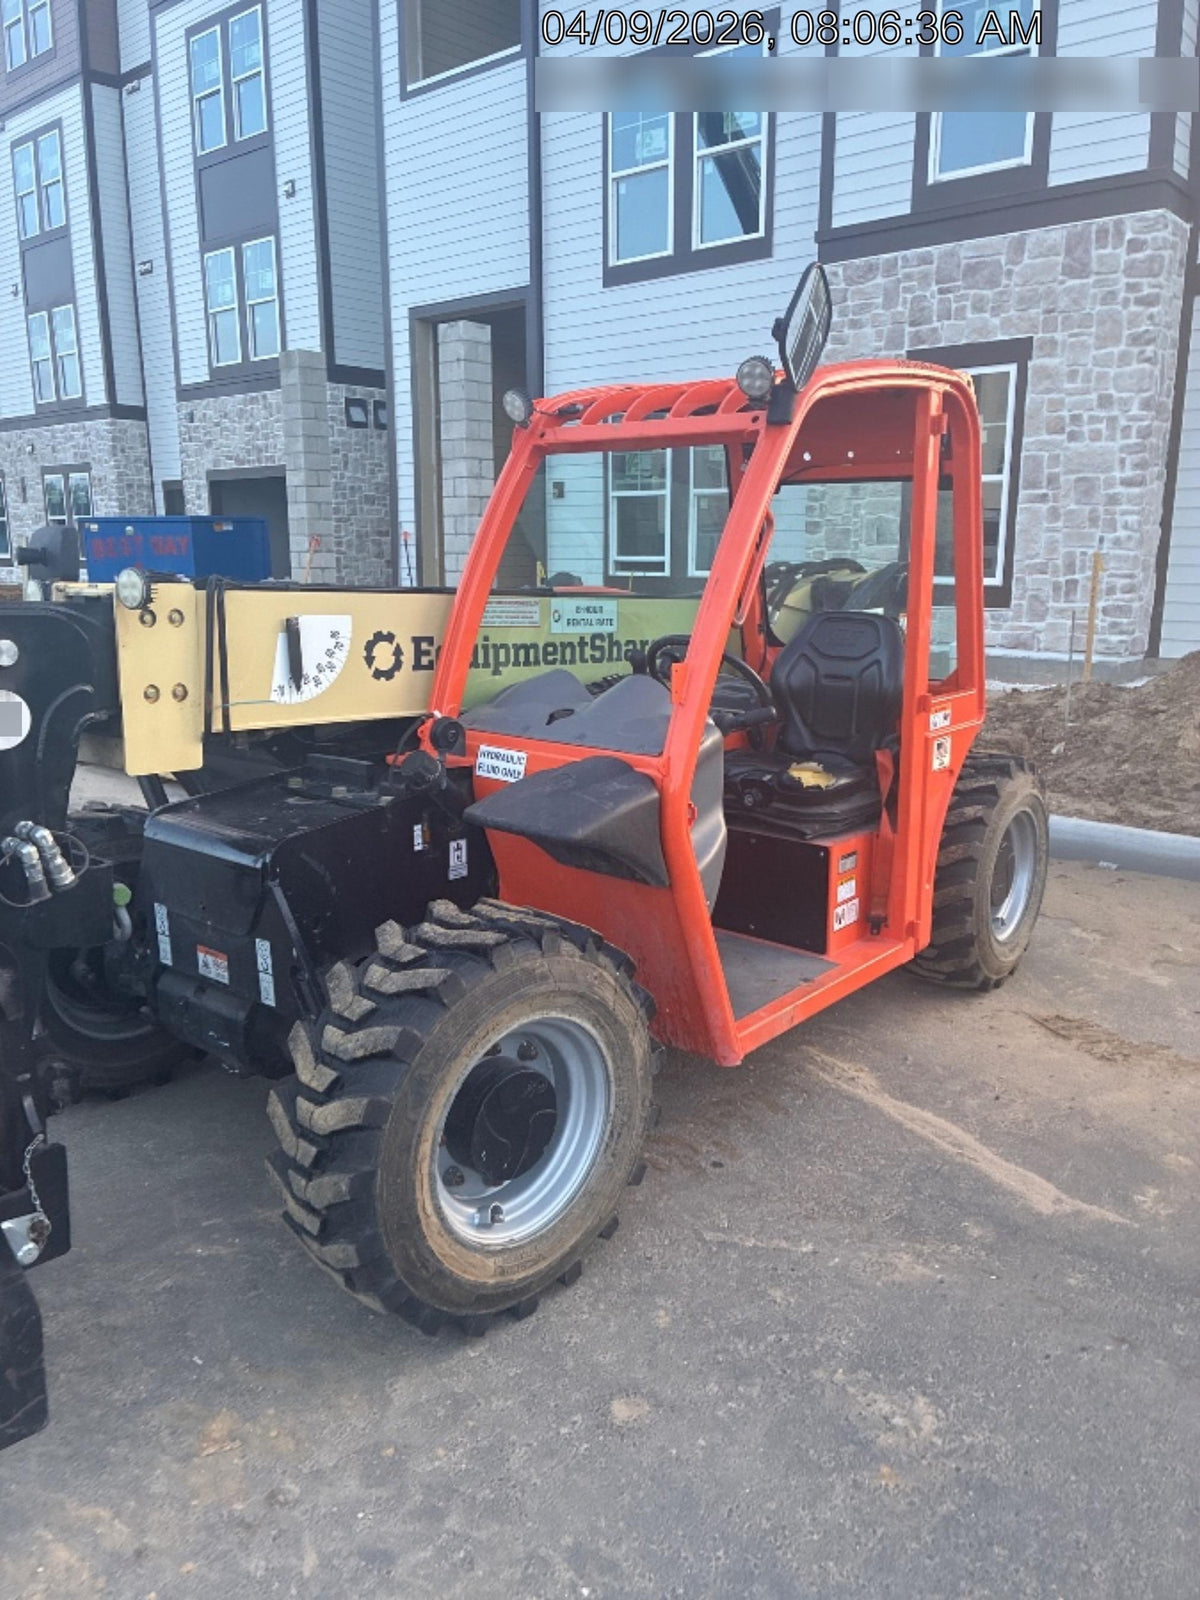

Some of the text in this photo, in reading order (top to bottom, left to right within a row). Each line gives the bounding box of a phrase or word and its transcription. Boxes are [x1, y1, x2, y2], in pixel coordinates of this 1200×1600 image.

[479, 750, 526, 765] HYDRAULIC
[477, 762, 521, 779] FLUID ONLY
